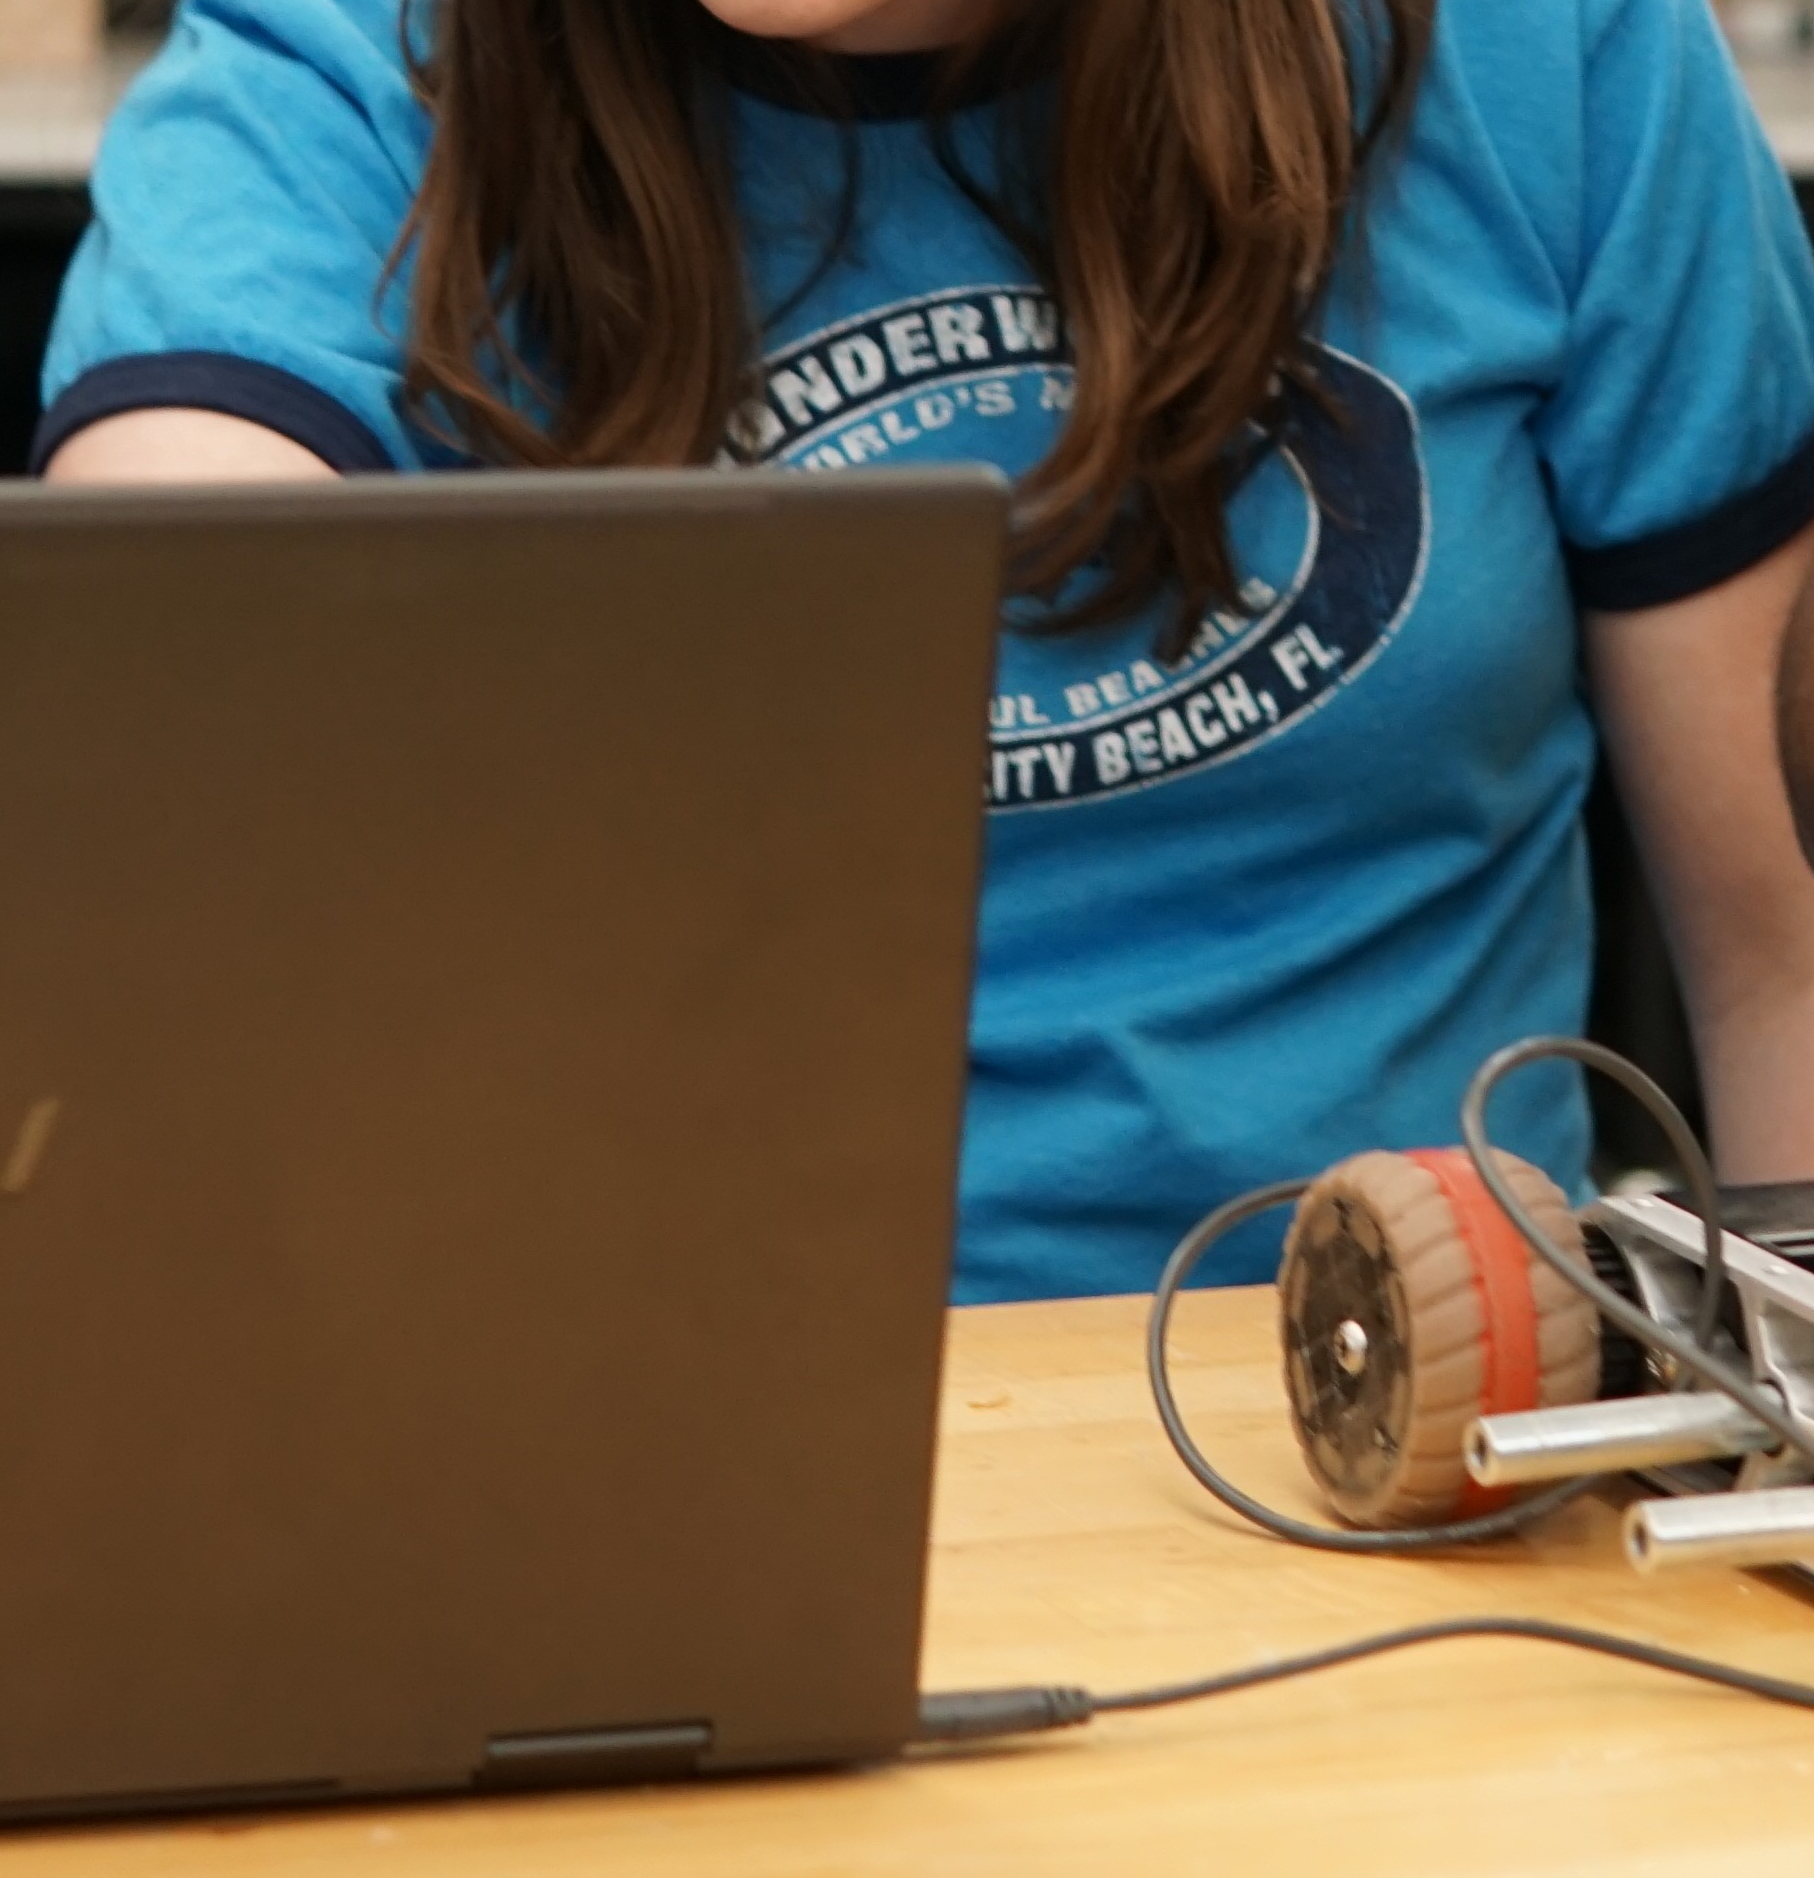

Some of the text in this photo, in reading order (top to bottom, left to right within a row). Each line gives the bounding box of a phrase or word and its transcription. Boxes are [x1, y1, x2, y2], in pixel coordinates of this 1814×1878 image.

[793, 381, 1015, 473] ORLD'S
[984, 742, 1075, 800] ITY
[1093, 673, 1279, 785] BEACH,
[1270, 623, 1343, 690] FL
